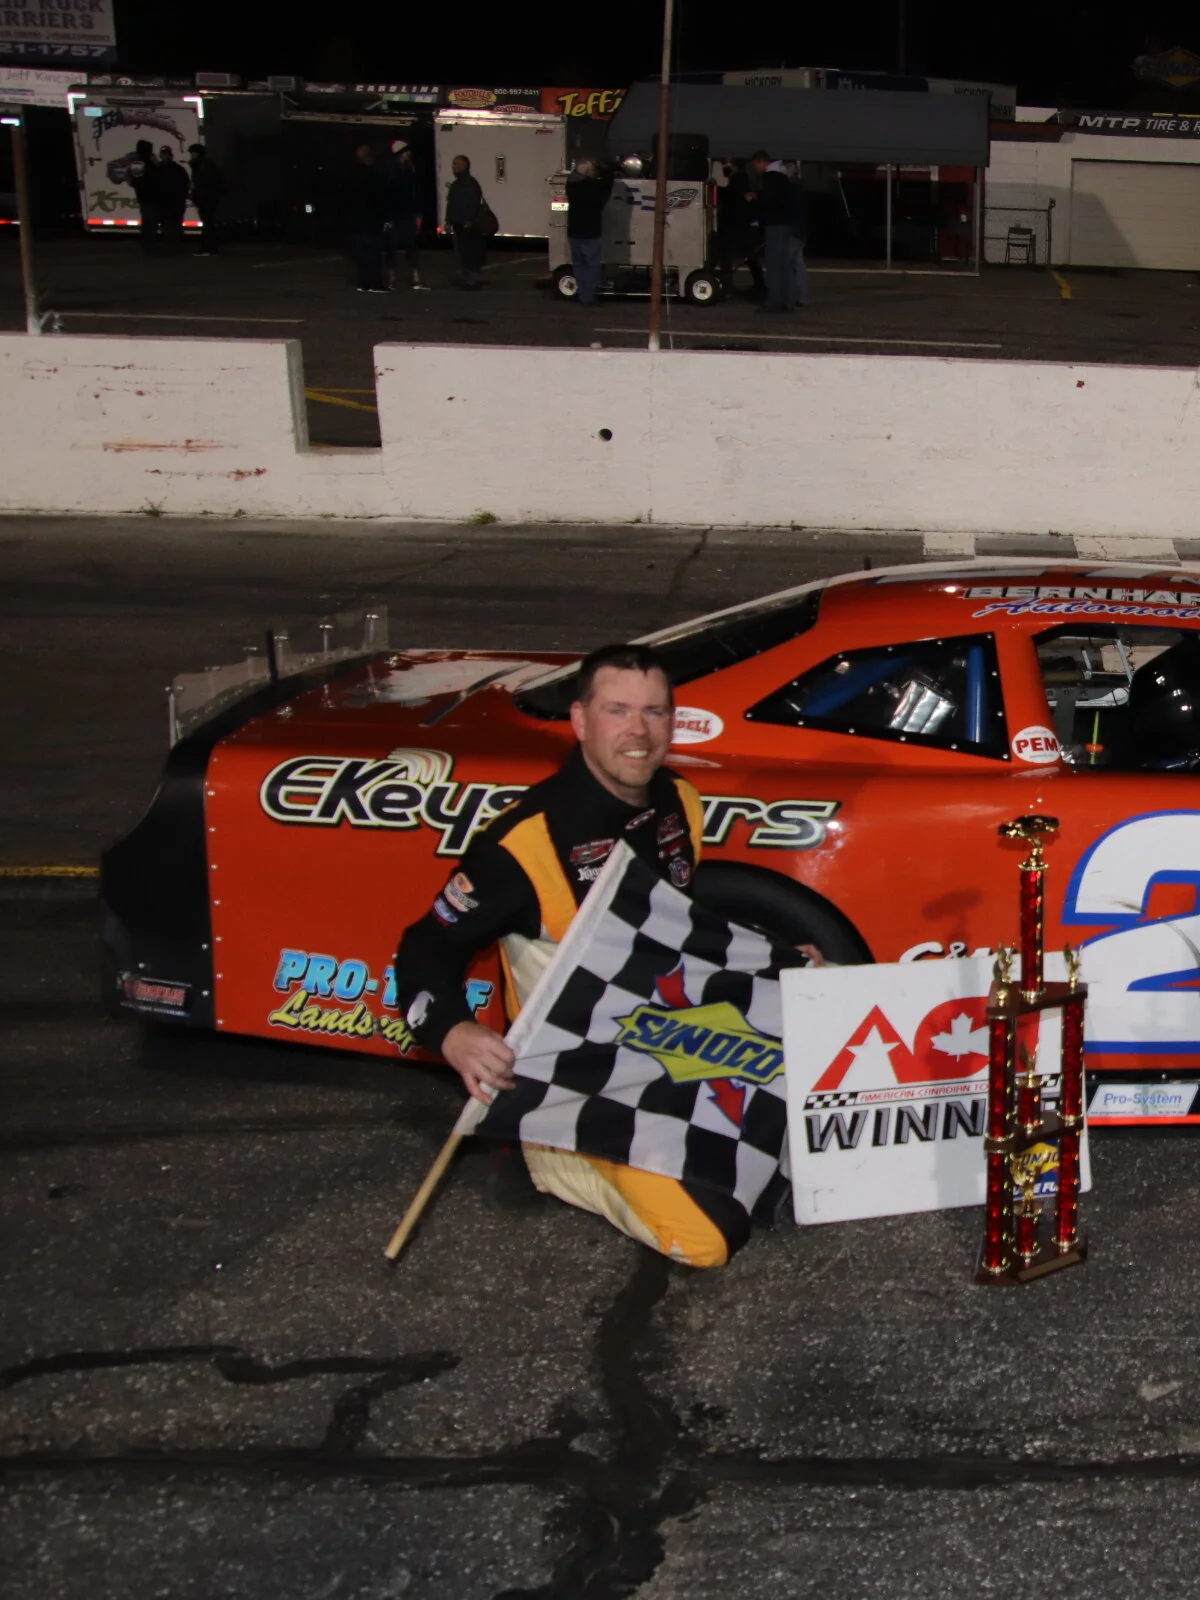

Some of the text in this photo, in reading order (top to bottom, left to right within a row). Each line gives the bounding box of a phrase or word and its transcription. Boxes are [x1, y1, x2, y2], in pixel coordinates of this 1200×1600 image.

[1079, 115, 1141, 129] MTP
[1145, 118, 1177, 132] TIRE
[1180, 120, 1190, 133] &
[623, 1012, 785, 1078] SUNOCO
[1103, 1092, 1183, 1106] Pro-System
